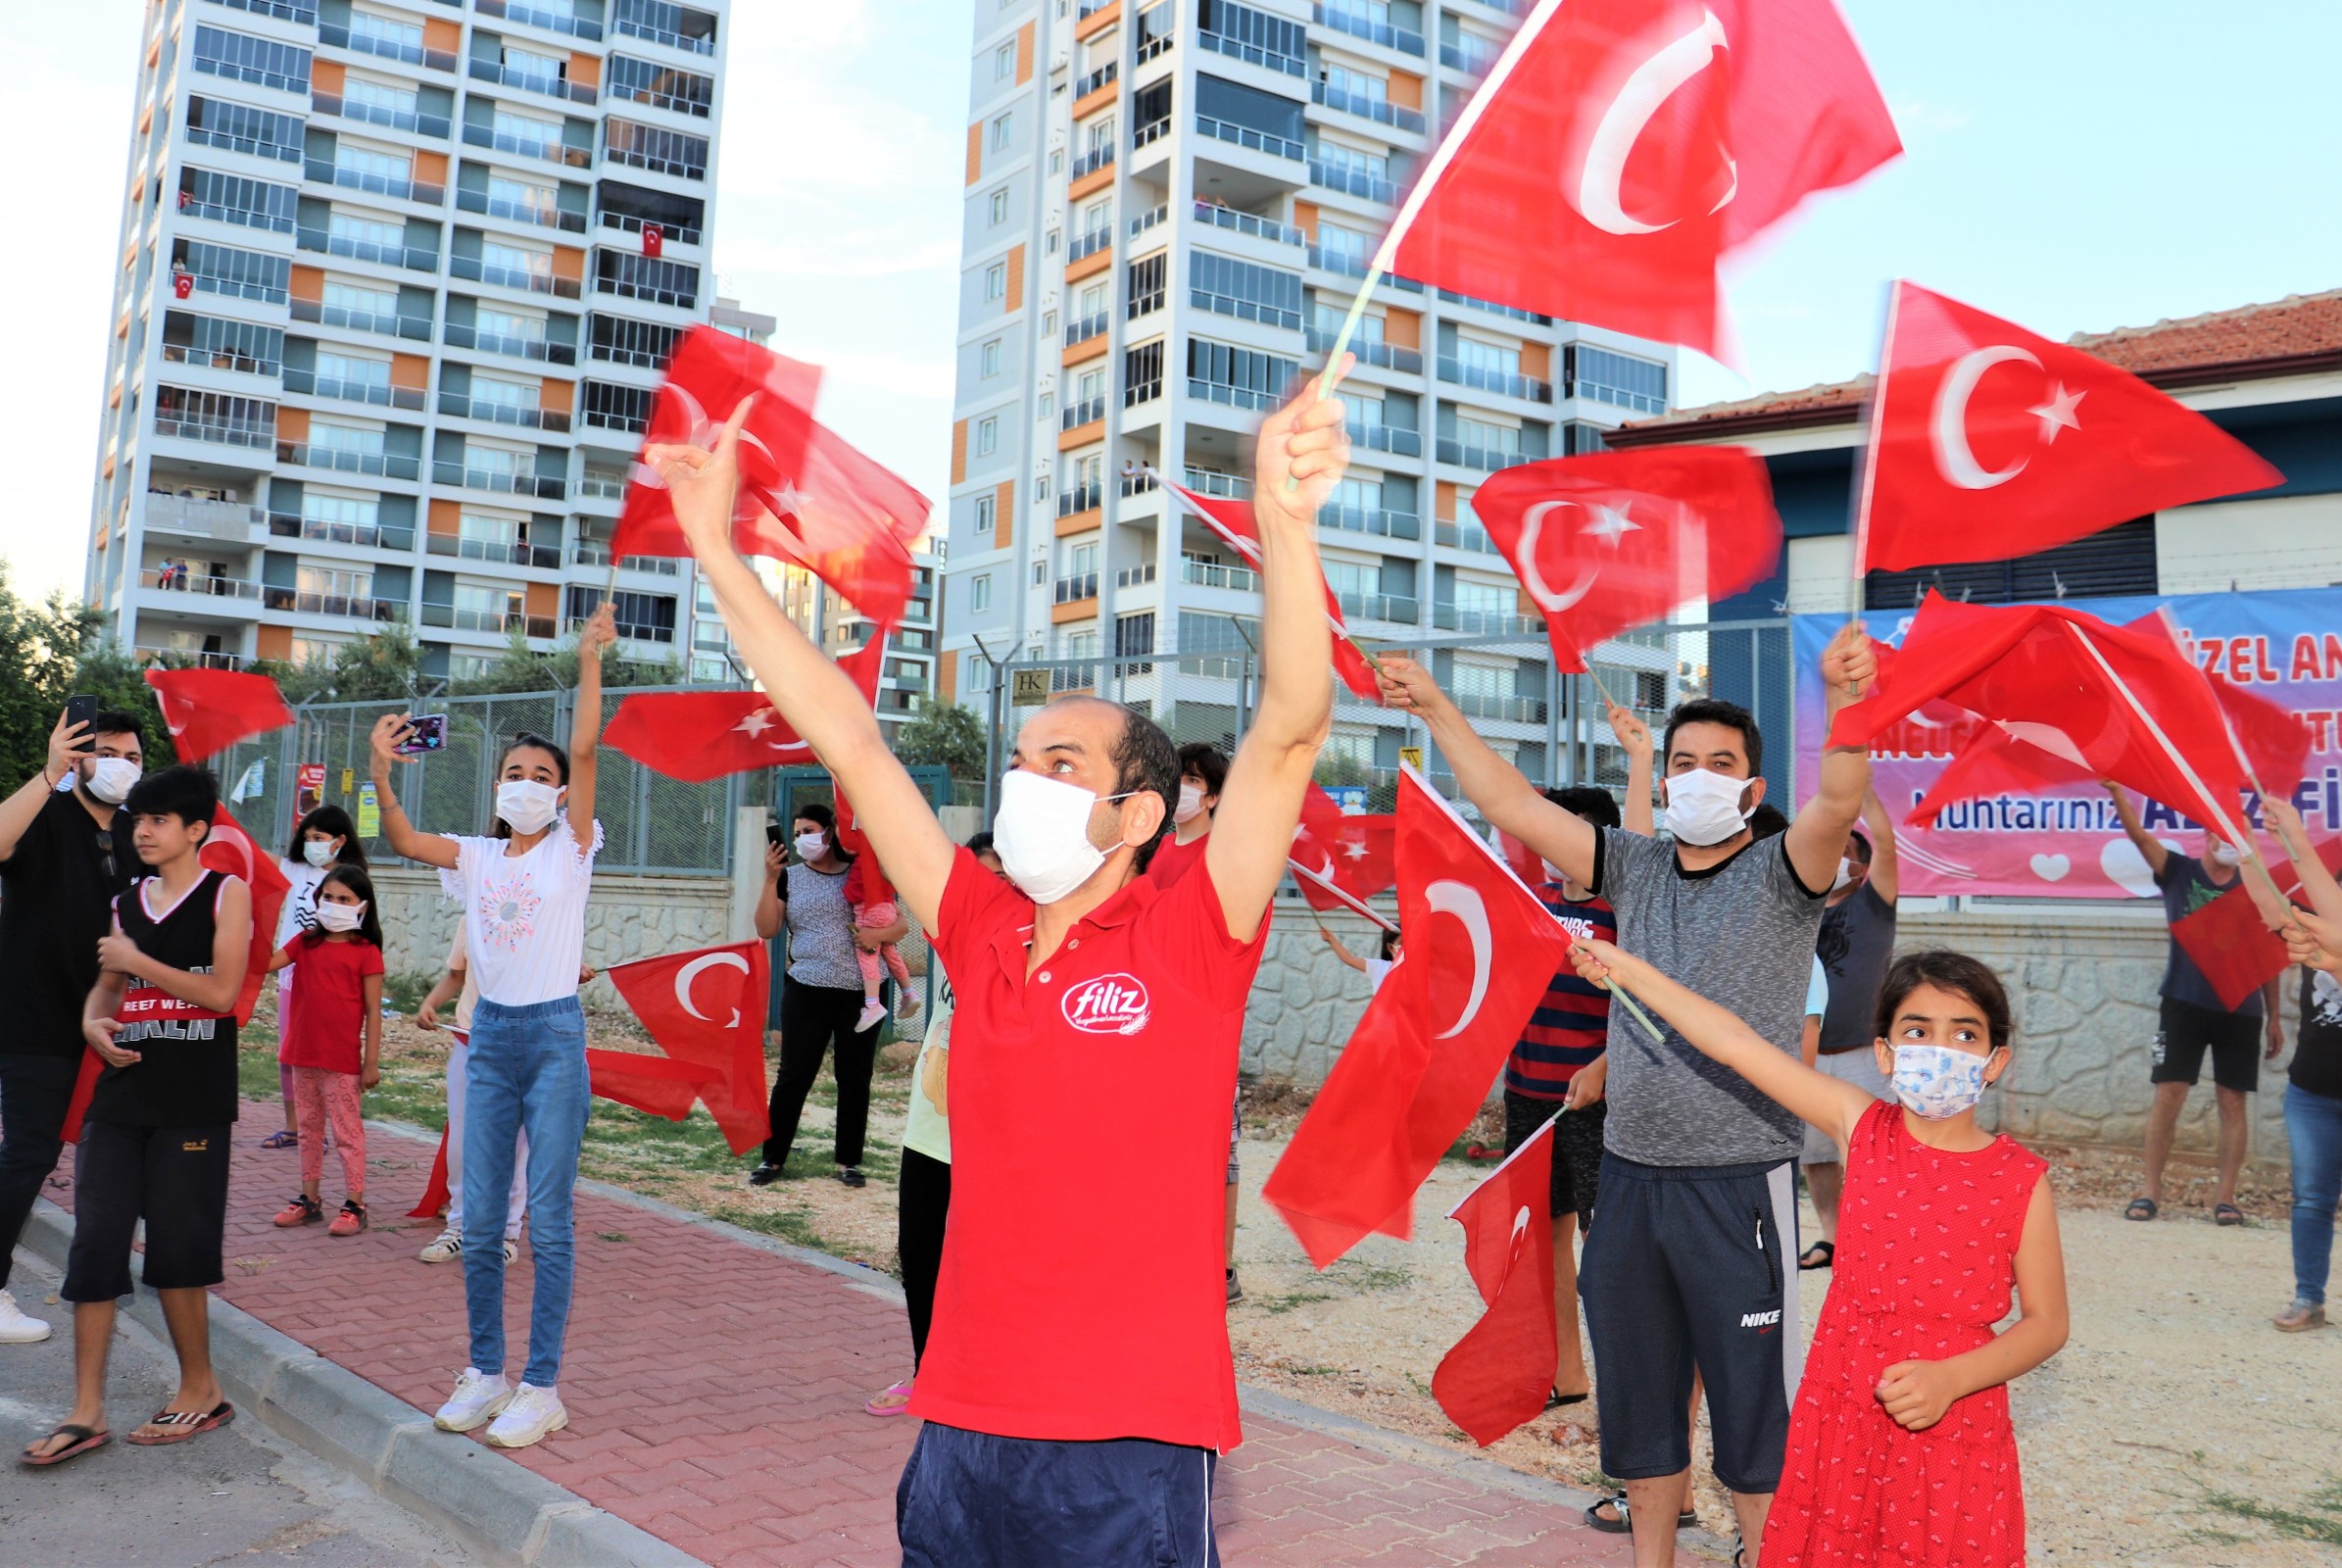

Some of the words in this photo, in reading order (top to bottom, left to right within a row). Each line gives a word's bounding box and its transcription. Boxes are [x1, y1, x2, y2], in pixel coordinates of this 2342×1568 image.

[1018, 674, 1043, 690] HK
[1071, 981, 1141, 1018] filiz
[1739, 1308, 1781, 1328] NIKE
